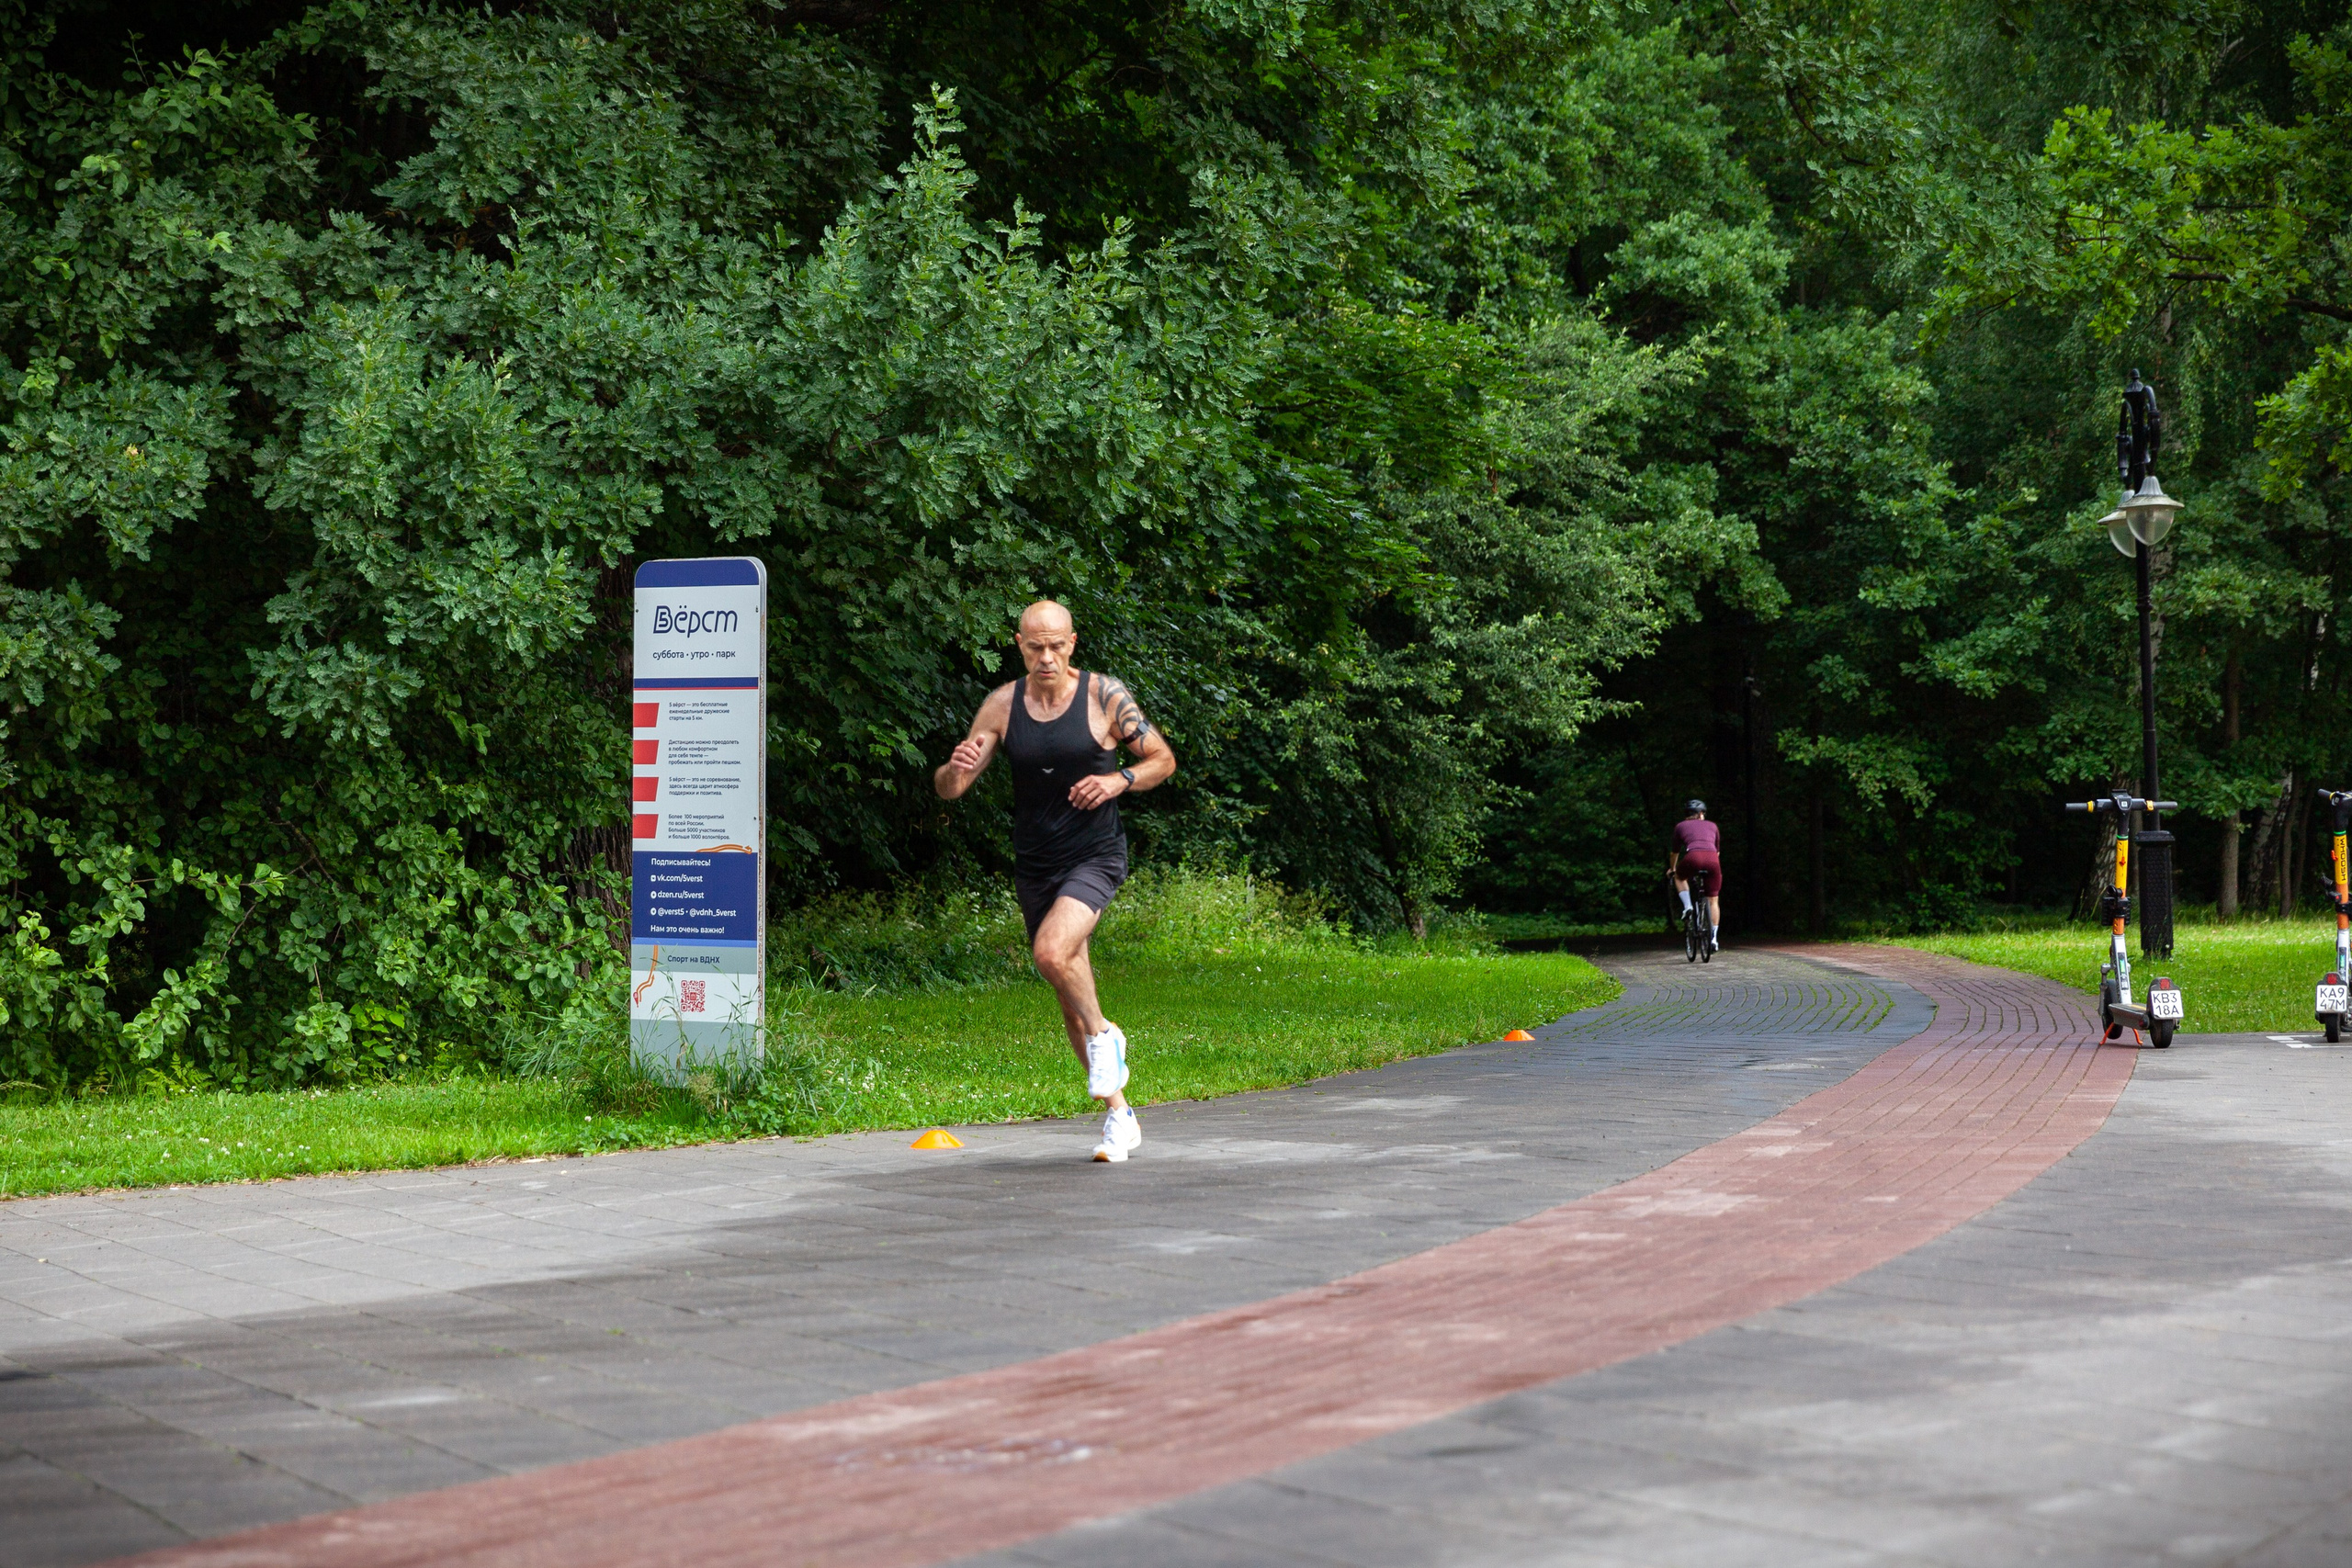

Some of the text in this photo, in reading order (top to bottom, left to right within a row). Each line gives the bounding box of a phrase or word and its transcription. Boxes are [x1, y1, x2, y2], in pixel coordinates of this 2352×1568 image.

[652, 649, 684, 660] суббота
[690, 651, 710, 660] утро
[716, 650, 736, 660] парк
[650, 858, 711, 866] Подписывайтесь!
[657, 874, 704, 883] vk.com/5verst
[657, 890, 705, 899] dzen.ru/5verst
[657, 908, 684, 917] @verst5
[689, 908, 737, 918] @vdnh_5verst
[700, 926, 725, 934] важно!
[667, 954, 689, 964] Спорт
[700, 955, 720, 964] ВДНХ
